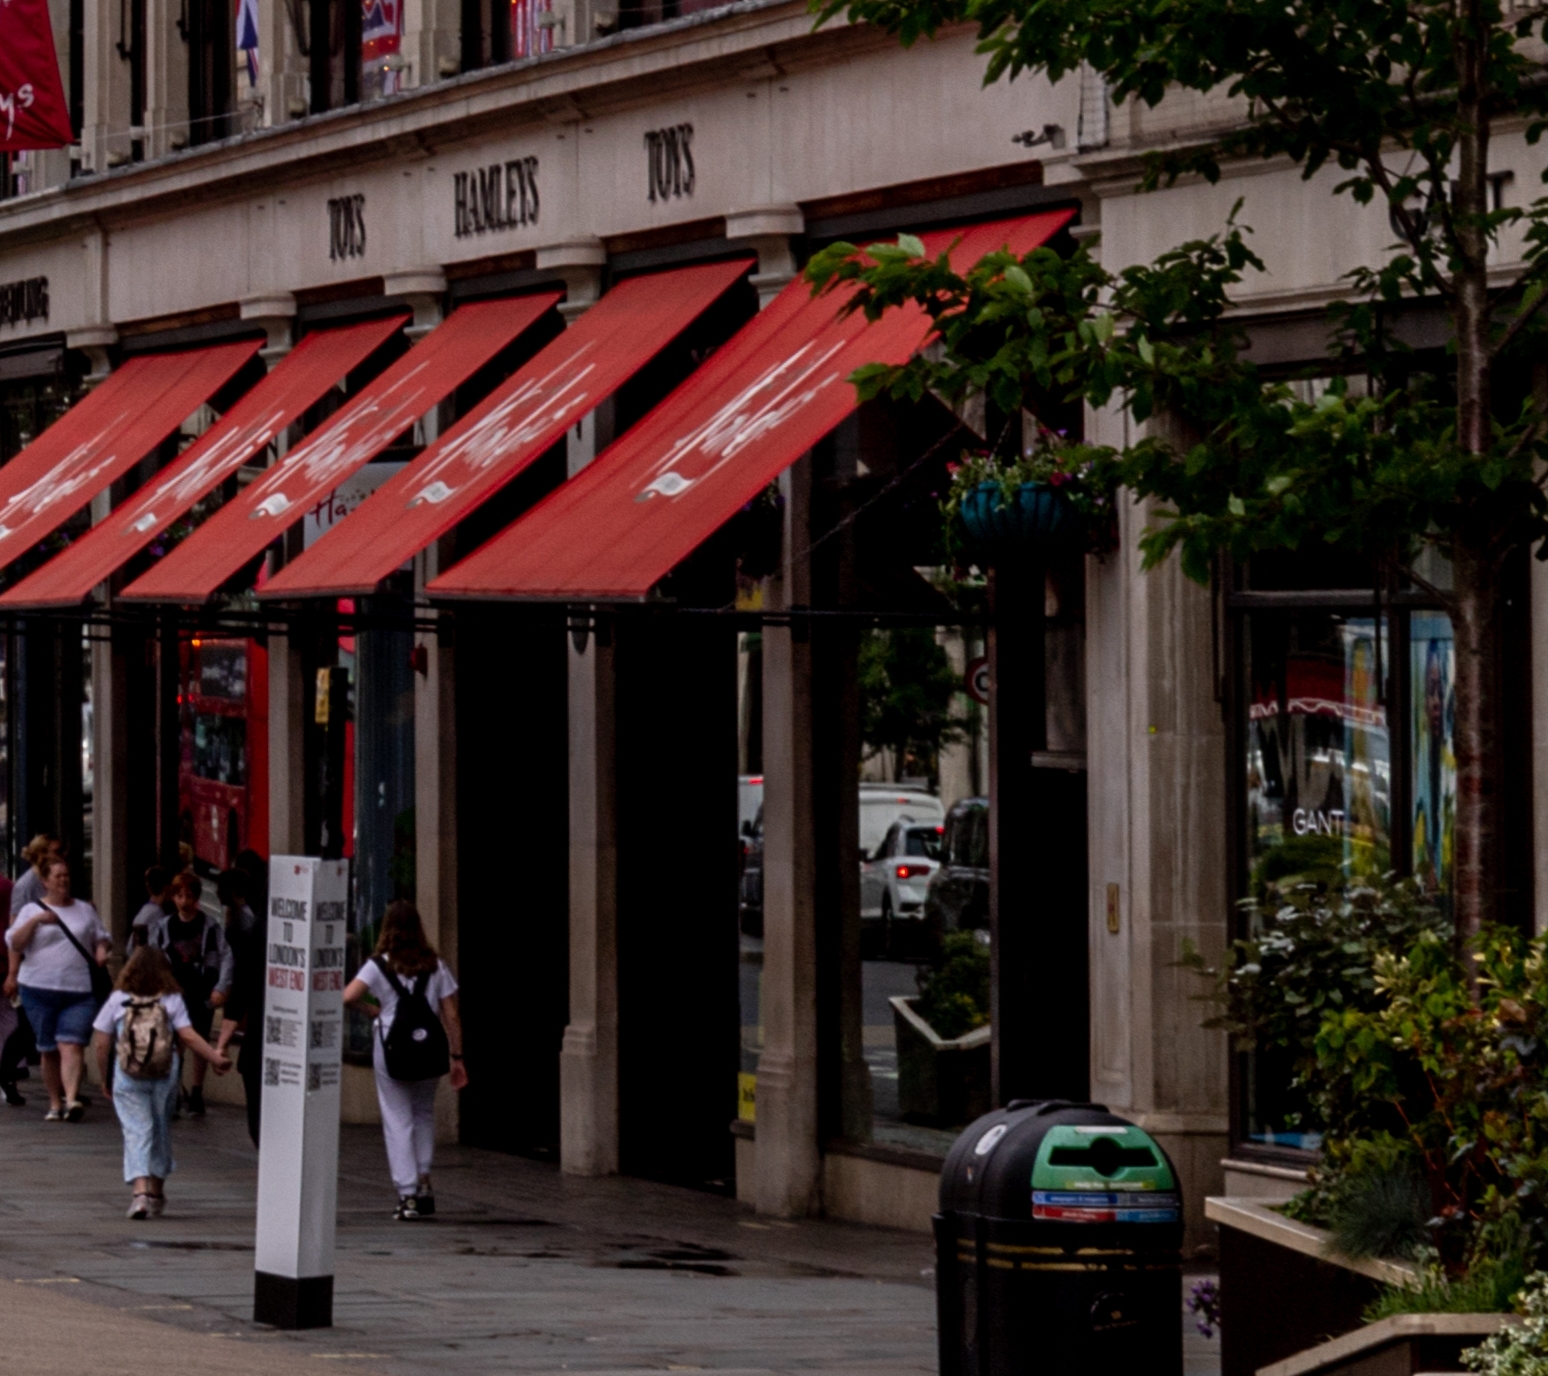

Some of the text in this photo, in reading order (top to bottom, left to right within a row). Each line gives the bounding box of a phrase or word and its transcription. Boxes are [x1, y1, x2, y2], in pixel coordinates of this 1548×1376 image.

[644, 123, 696, 203] TOYS
[453, 155, 540, 238] HAMLEYS
[1293, 808, 1345, 836] GANT
[271, 897, 307, 922] WELCOME
